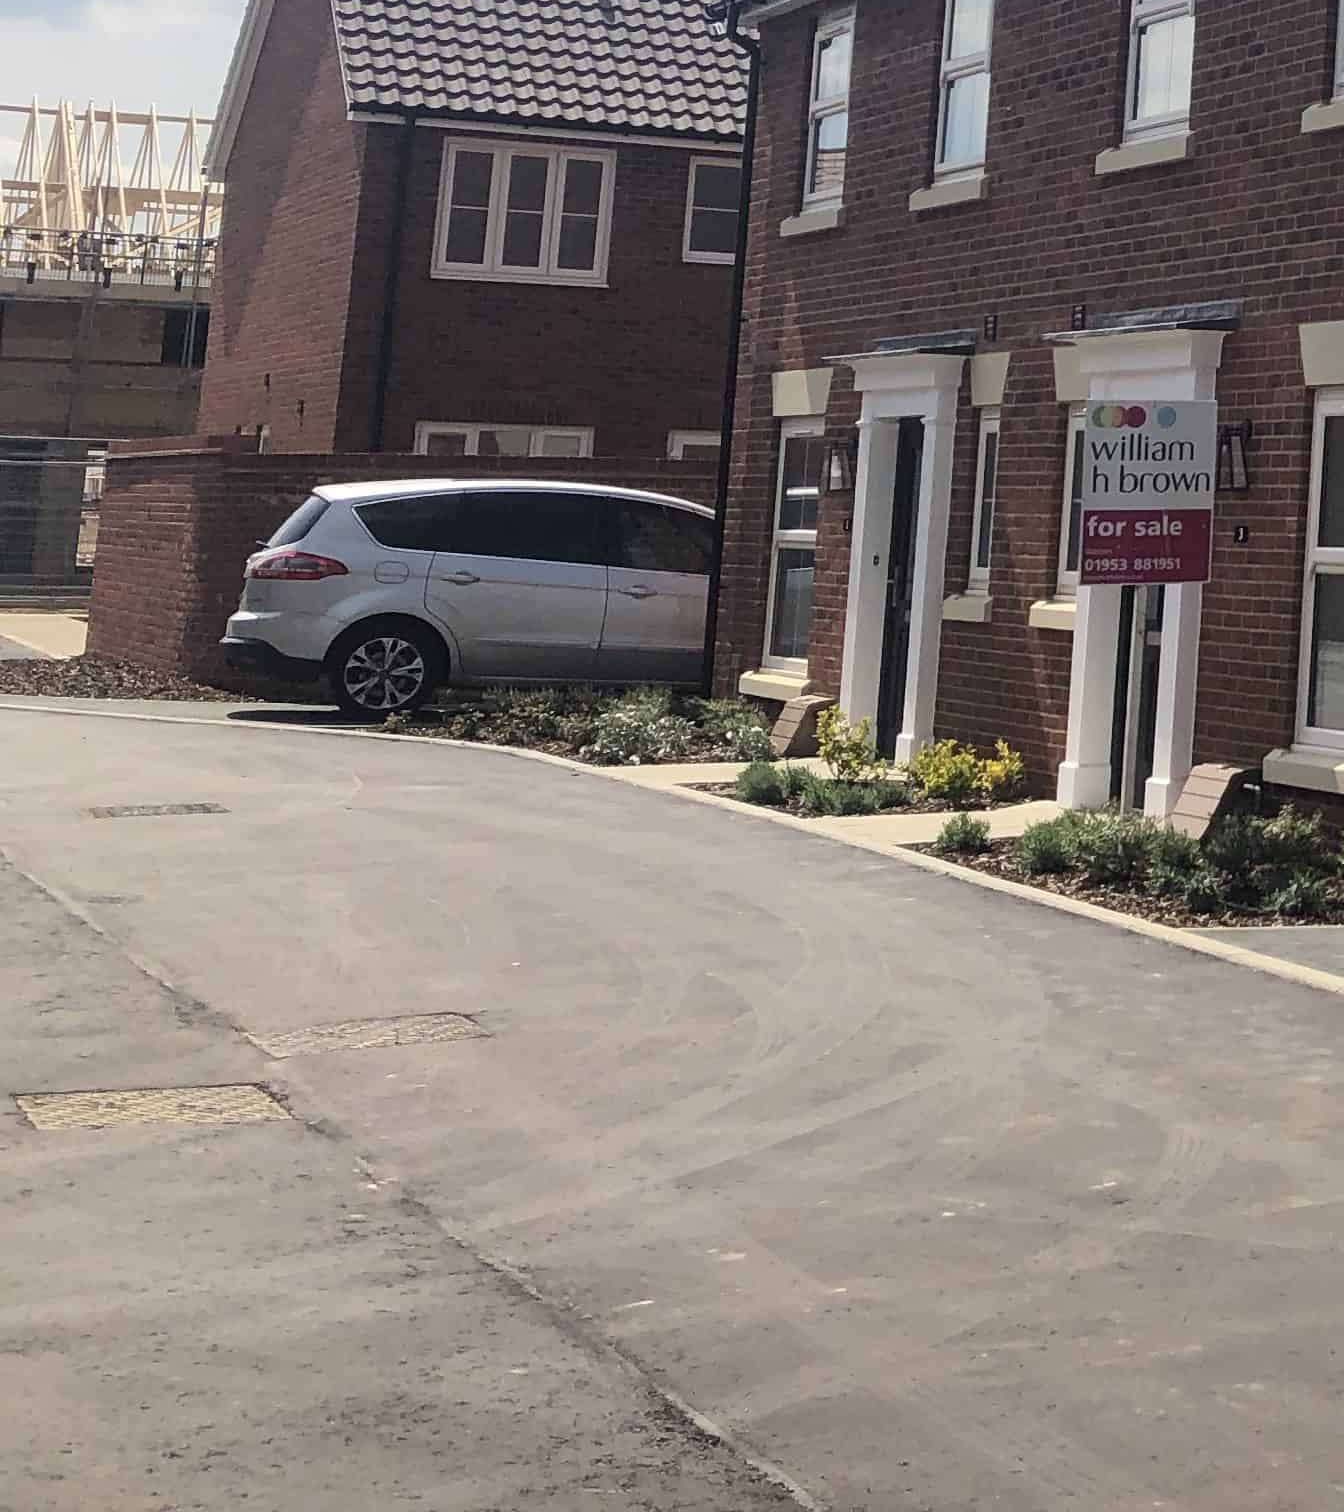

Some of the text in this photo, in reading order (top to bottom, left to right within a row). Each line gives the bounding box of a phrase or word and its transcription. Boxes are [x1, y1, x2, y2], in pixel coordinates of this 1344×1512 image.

[1091, 433, 1194, 462] william
[1092, 465, 1210, 493] h brown
[1087, 514, 1183, 537] for sale
[1085, 557, 1181, 571] 01953 881951
